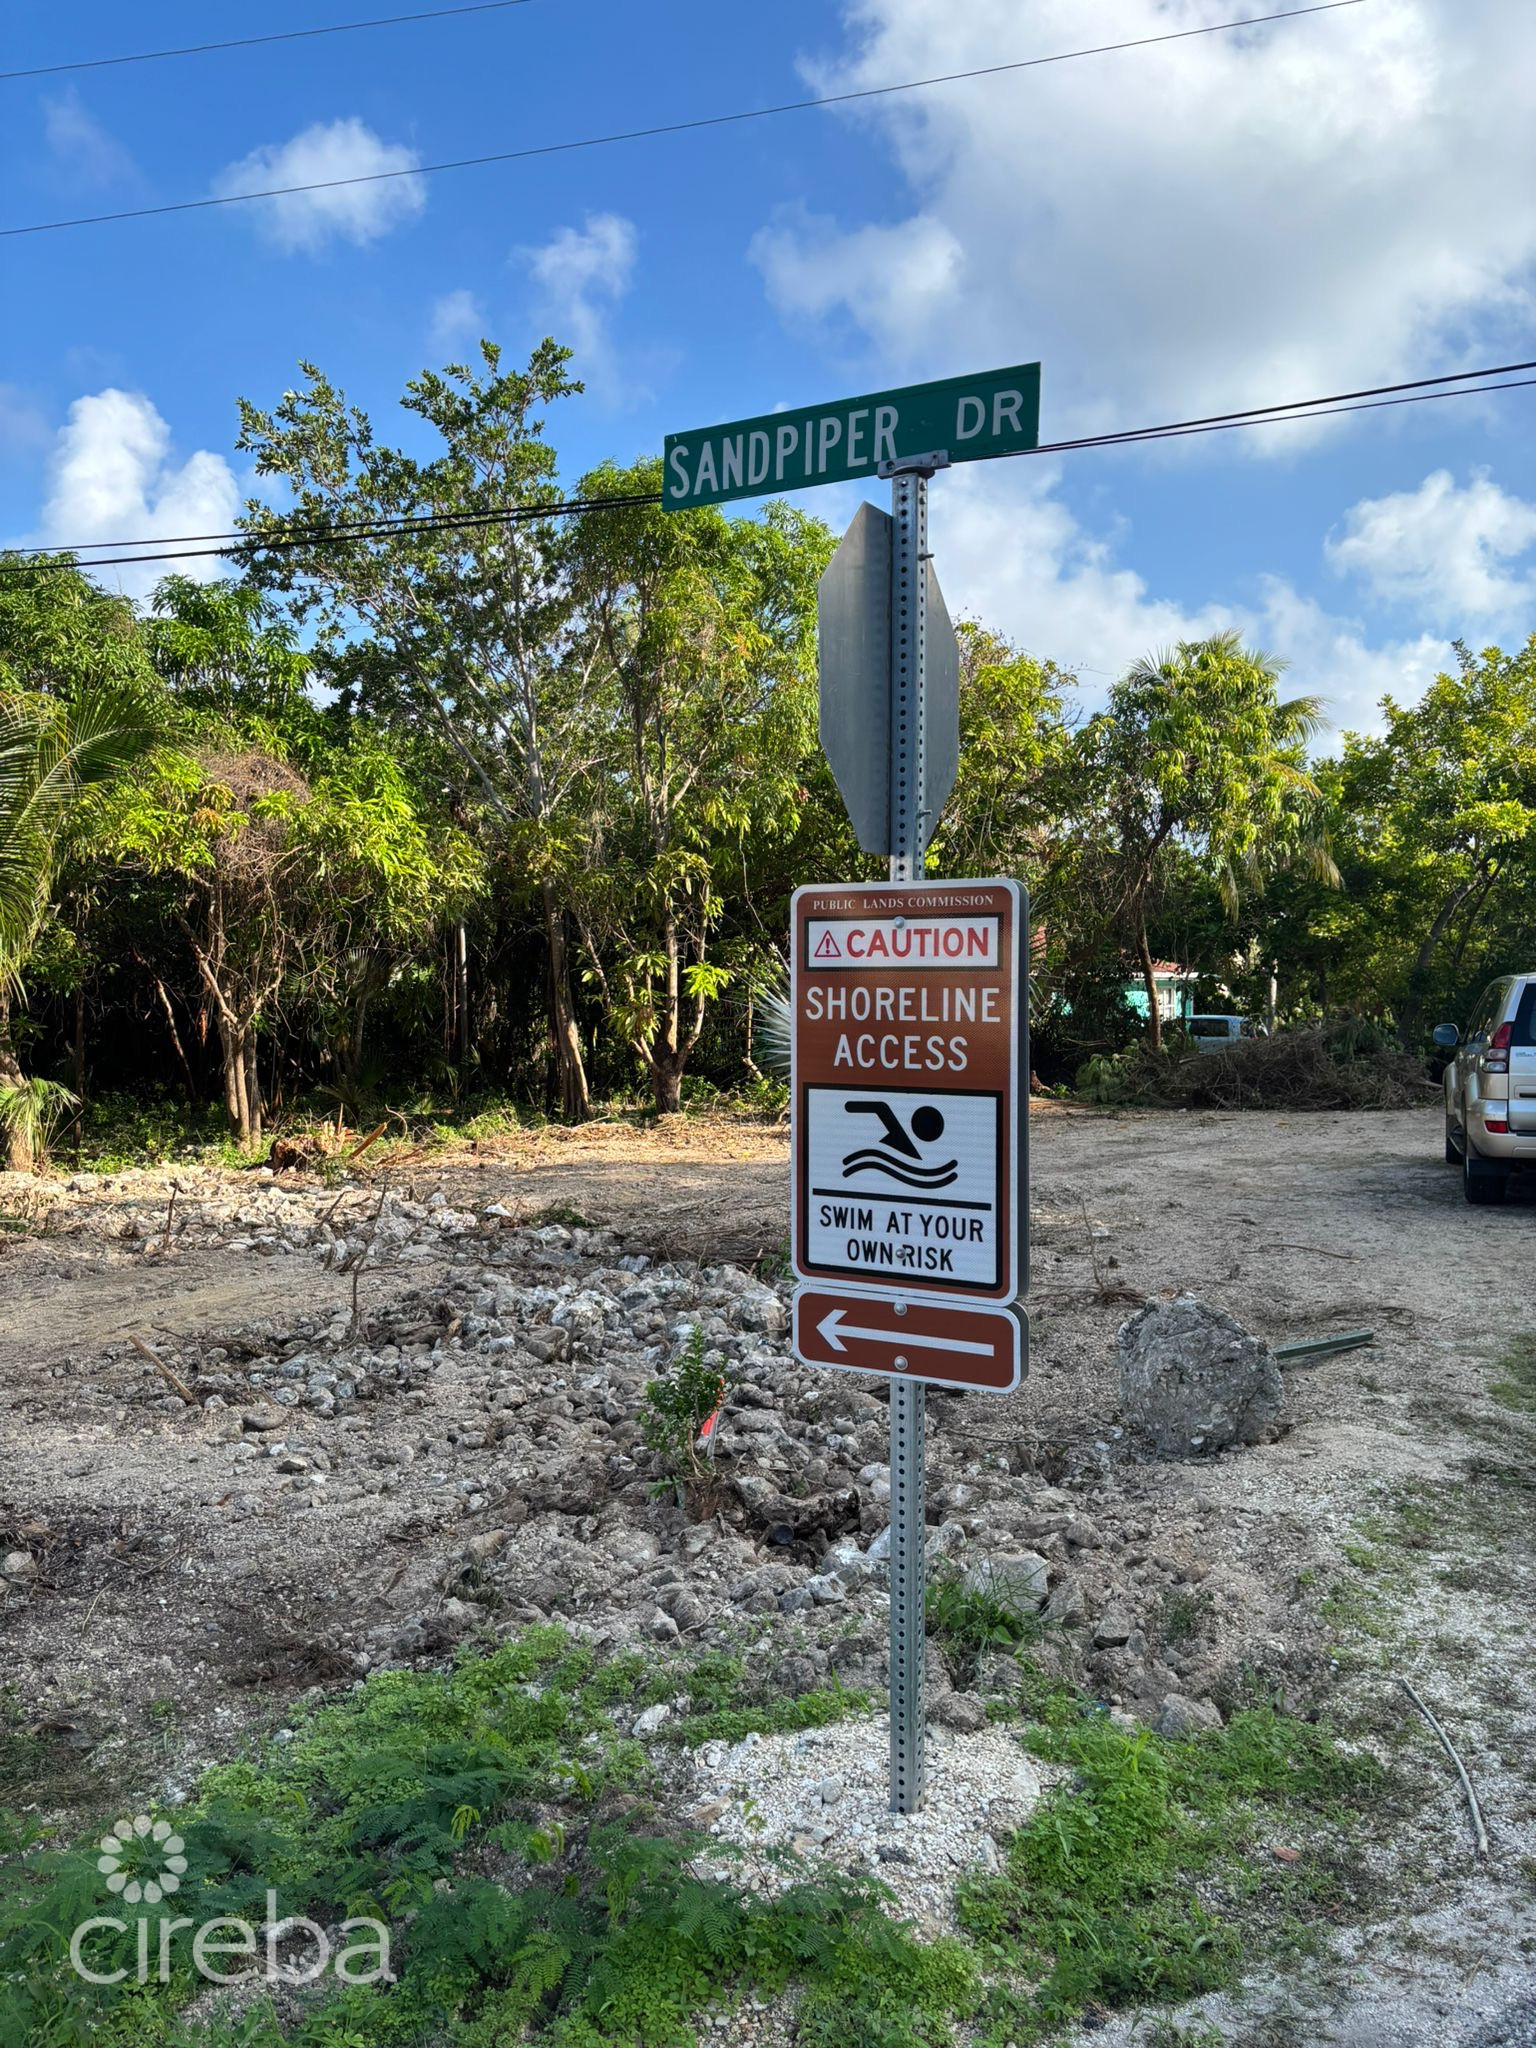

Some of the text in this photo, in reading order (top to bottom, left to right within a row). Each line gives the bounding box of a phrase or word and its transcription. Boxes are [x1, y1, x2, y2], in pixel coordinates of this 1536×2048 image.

[669, 389, 1024, 499] SANDPIPER DR
[813, 894, 994, 910] PUBLIC LANDS COMMISSION
[846, 926, 989, 959] CAUTION
[805, 986, 1001, 1023] SHORELINE
[833, 1033, 968, 1072] ACCESS
[820, 1204, 984, 1243] SWIM AT YOUR
[847, 1238, 954, 1272] OWN RISK
